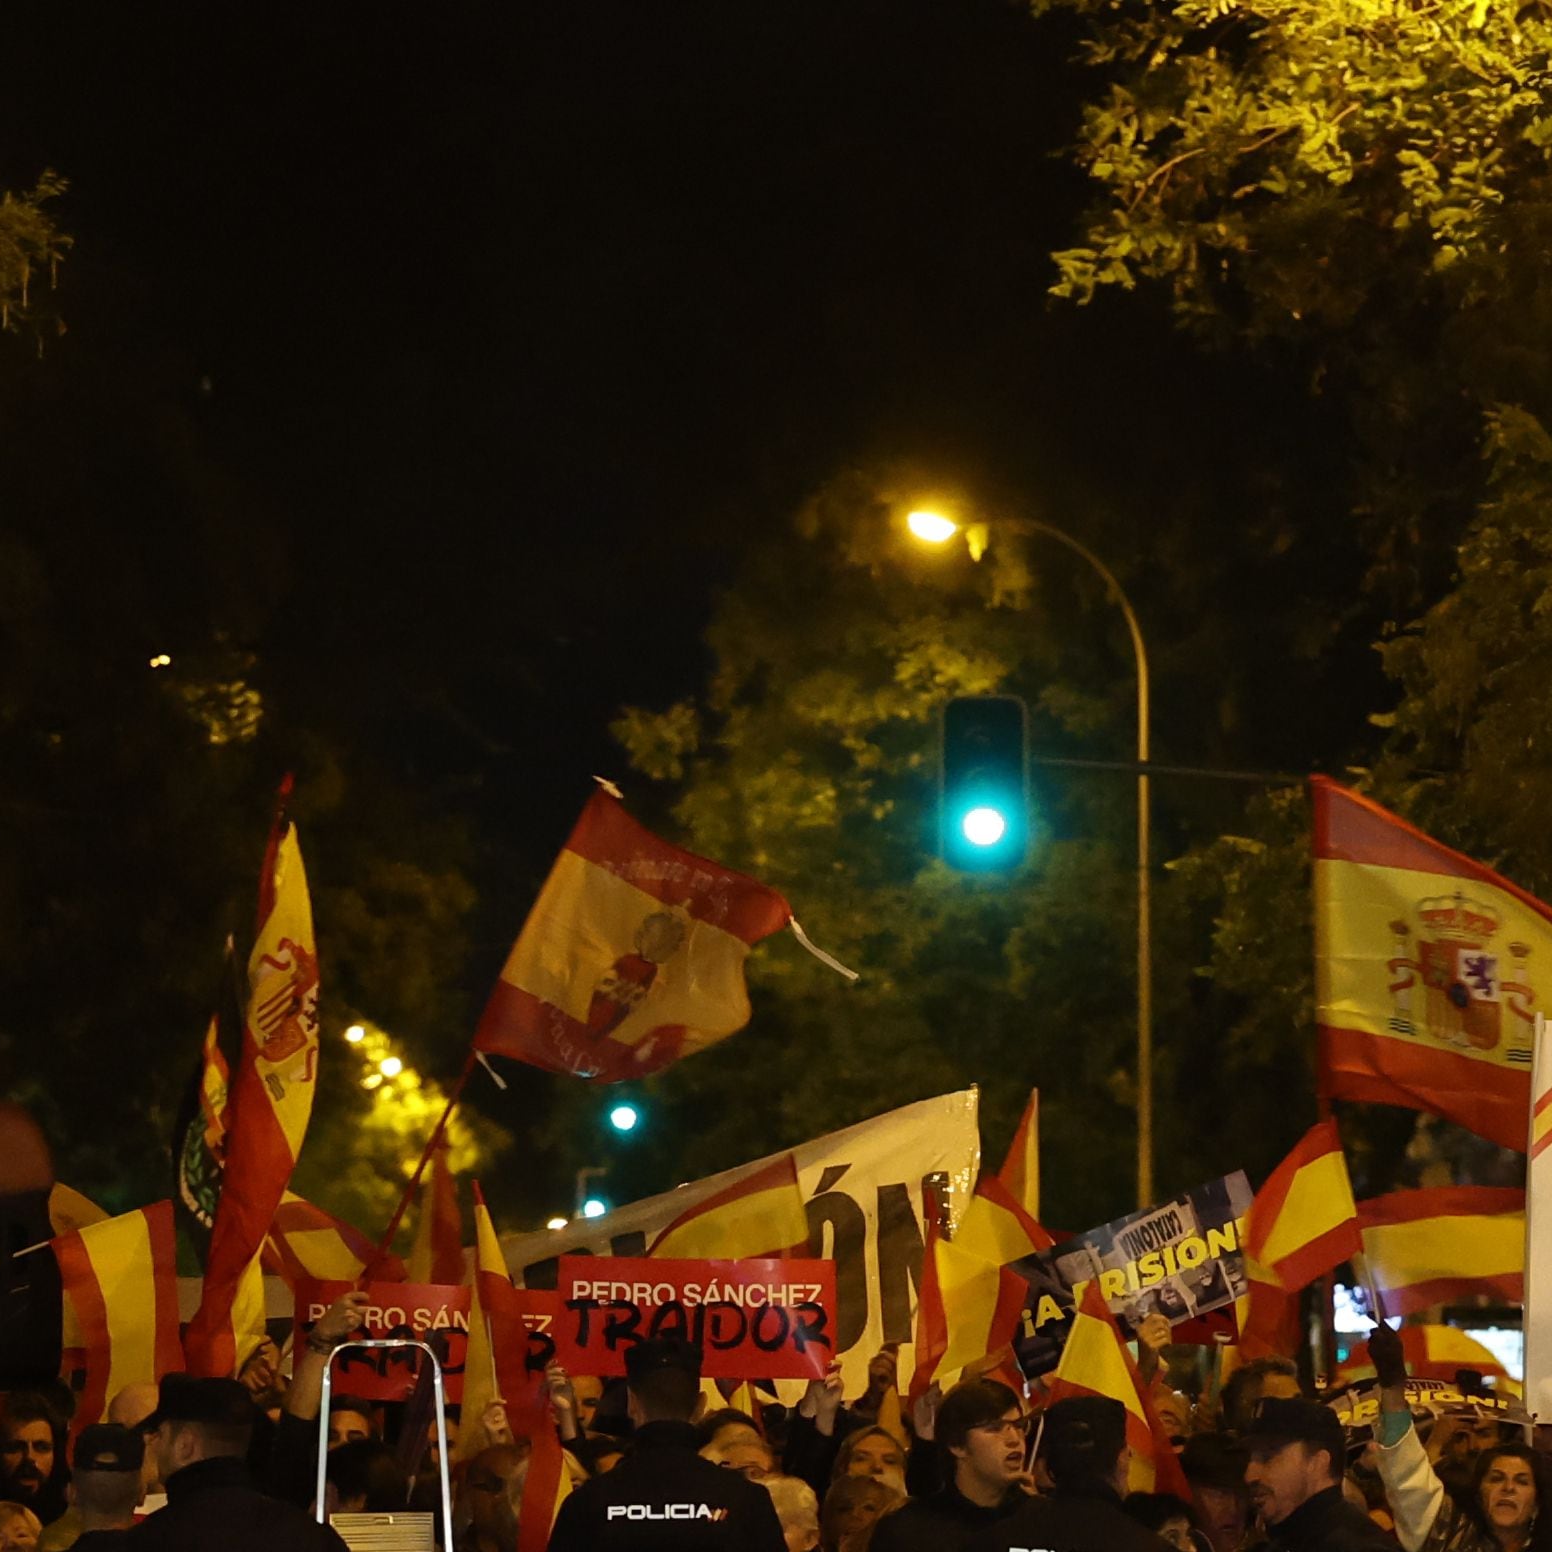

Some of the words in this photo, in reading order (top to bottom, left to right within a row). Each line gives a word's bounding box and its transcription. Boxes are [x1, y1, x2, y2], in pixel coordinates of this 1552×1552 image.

[572, 1280, 676, 1307] PEDRO
[682, 1278, 823, 1309] SÁNCHEZ
[308, 1303, 406, 1331] PRO
[607, 1503, 713, 1520] POLICIA
